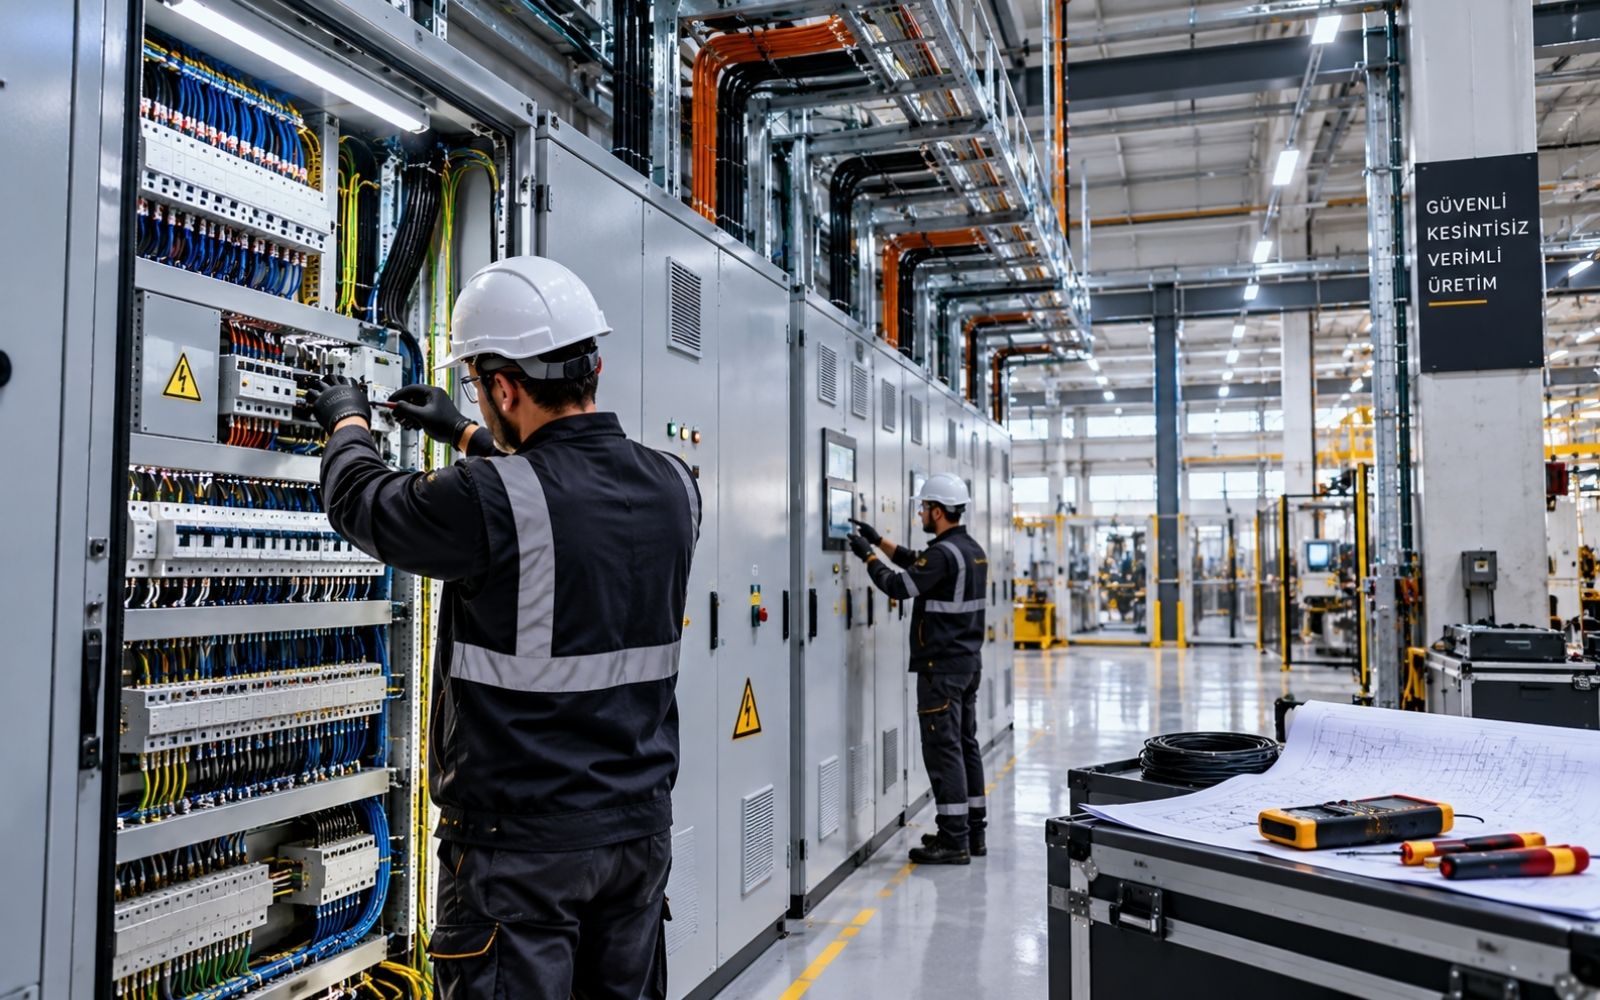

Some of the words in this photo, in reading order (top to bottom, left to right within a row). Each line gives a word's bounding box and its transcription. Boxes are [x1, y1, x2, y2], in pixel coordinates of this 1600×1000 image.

[1426, 191, 1506, 215] GÜVENLİ
[1427, 218, 1529, 241] KESİNTİSİZ
[1427, 246, 1501, 267] VERİMLİ
[1428, 273, 1497, 294] ÜRETİM
